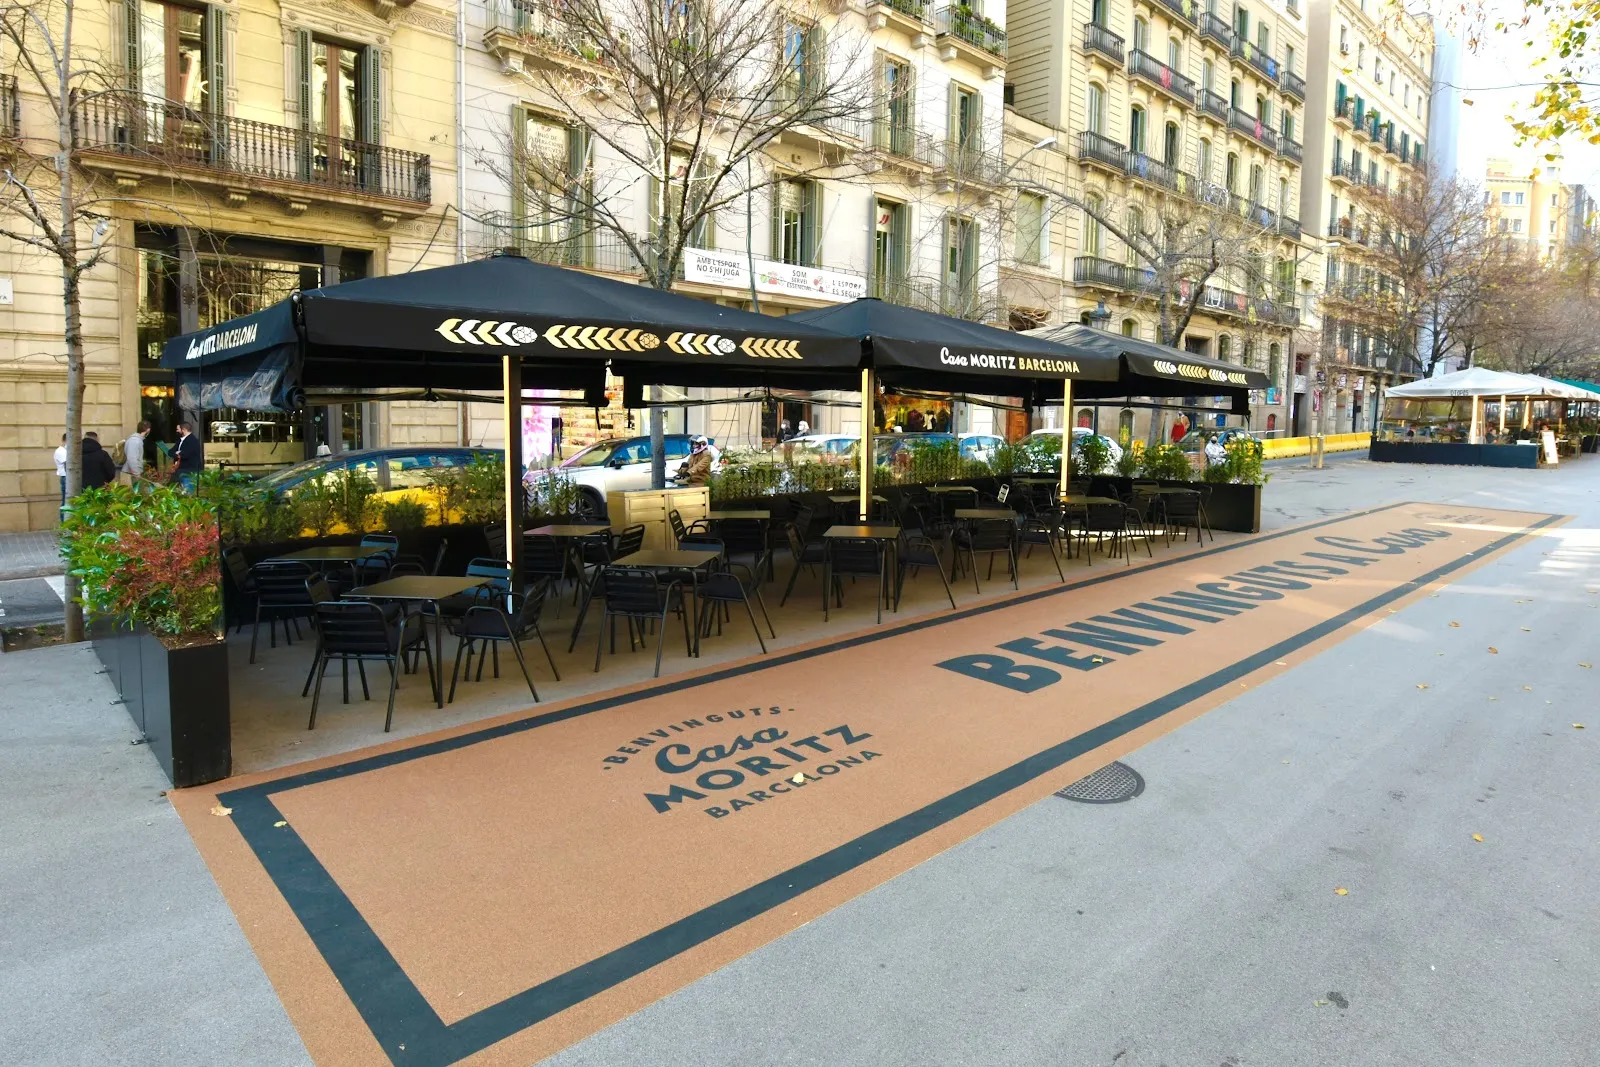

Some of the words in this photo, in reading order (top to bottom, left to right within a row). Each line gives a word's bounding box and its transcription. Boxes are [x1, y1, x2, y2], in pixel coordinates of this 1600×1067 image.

[696, 256, 712, 265] AMB
[696, 264, 708, 272] NO
[709, 265, 722, 274] S'HI
[723, 267, 740, 277] JUGA
[792, 270, 807, 278] SOM
[216, 323, 258, 351] BARCELONA
[941, 346, 969, 367] Casa
[970, 353, 1016, 370] MORITZ
[1018, 357, 1080, 373] BARCELONA
[1314, 527, 1453, 555] Casa
[1301, 551, 1380, 567] A
[934, 560, 1349, 694] BENVINGUTS
[602, 706, 781, 764] BENVINGUTS
[654, 727, 789, 775] Casa
[643, 724, 873, 814] MORITZ
[704, 750, 883, 819] BARCELONA
